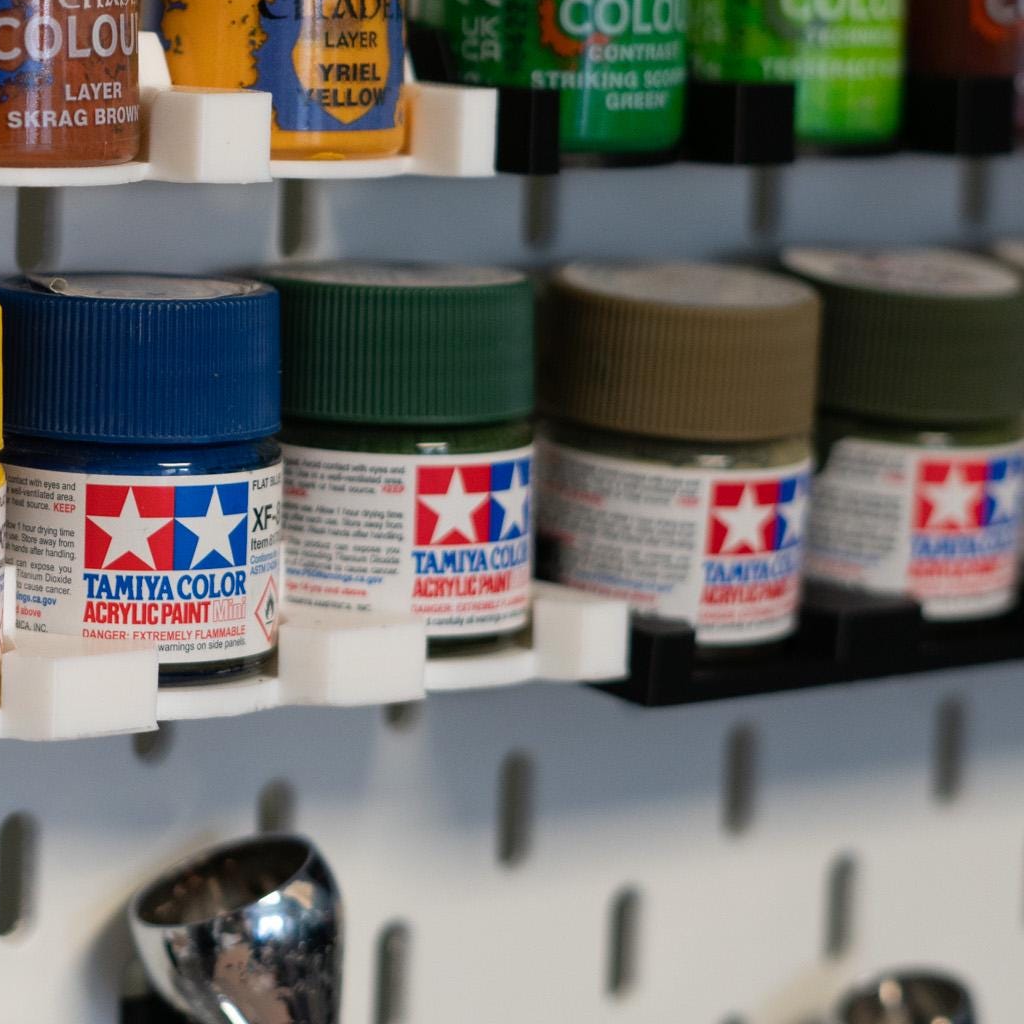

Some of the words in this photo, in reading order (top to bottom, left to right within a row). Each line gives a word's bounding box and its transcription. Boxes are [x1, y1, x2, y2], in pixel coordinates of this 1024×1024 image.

[324, 31, 378, 49] LAYER
[318, 62, 381, 83] YRIEL
[64, 82, 123, 102] LAYER
[303, 87, 390, 107] YELLOW
[7, 109, 88, 129] SKRAG
[43, 480, 60, 490] eyes
[62, 482, 76, 491] and
[252, 476, 269, 491] FLAT
[53, 502, 76, 513] KEEP
[37, 524, 58, 537] drying
[59, 527, 75, 537] time
[38, 538, 56, 548] away
[58, 538, 75, 548] from
[250, 537, 269, 551] Item
[30, 561, 55, 572] expose
[59, 565, 72, 574] you
[411, 550, 488, 575] TAMIYA
[45, 573, 72, 585] Dioxide
[83, 572, 174, 601] TAMIYA
[176, 570, 247, 599] COLOR
[23, 582, 43, 593] cause
[412, 577, 477, 598] ACRYLIC
[20, 607, 42, 618] above
[83, 601, 159, 625] ACRYLIC
[161, 601, 211, 625] PAINT
[212, 595, 247, 623] Mini
[132, 630, 193, 641] EXTREMELY
[194, 624, 245, 640] FLAMMABLE
[158, 642, 195, 653] warnings
[197, 641, 207, 650] on
[208, 639, 223, 649] side
